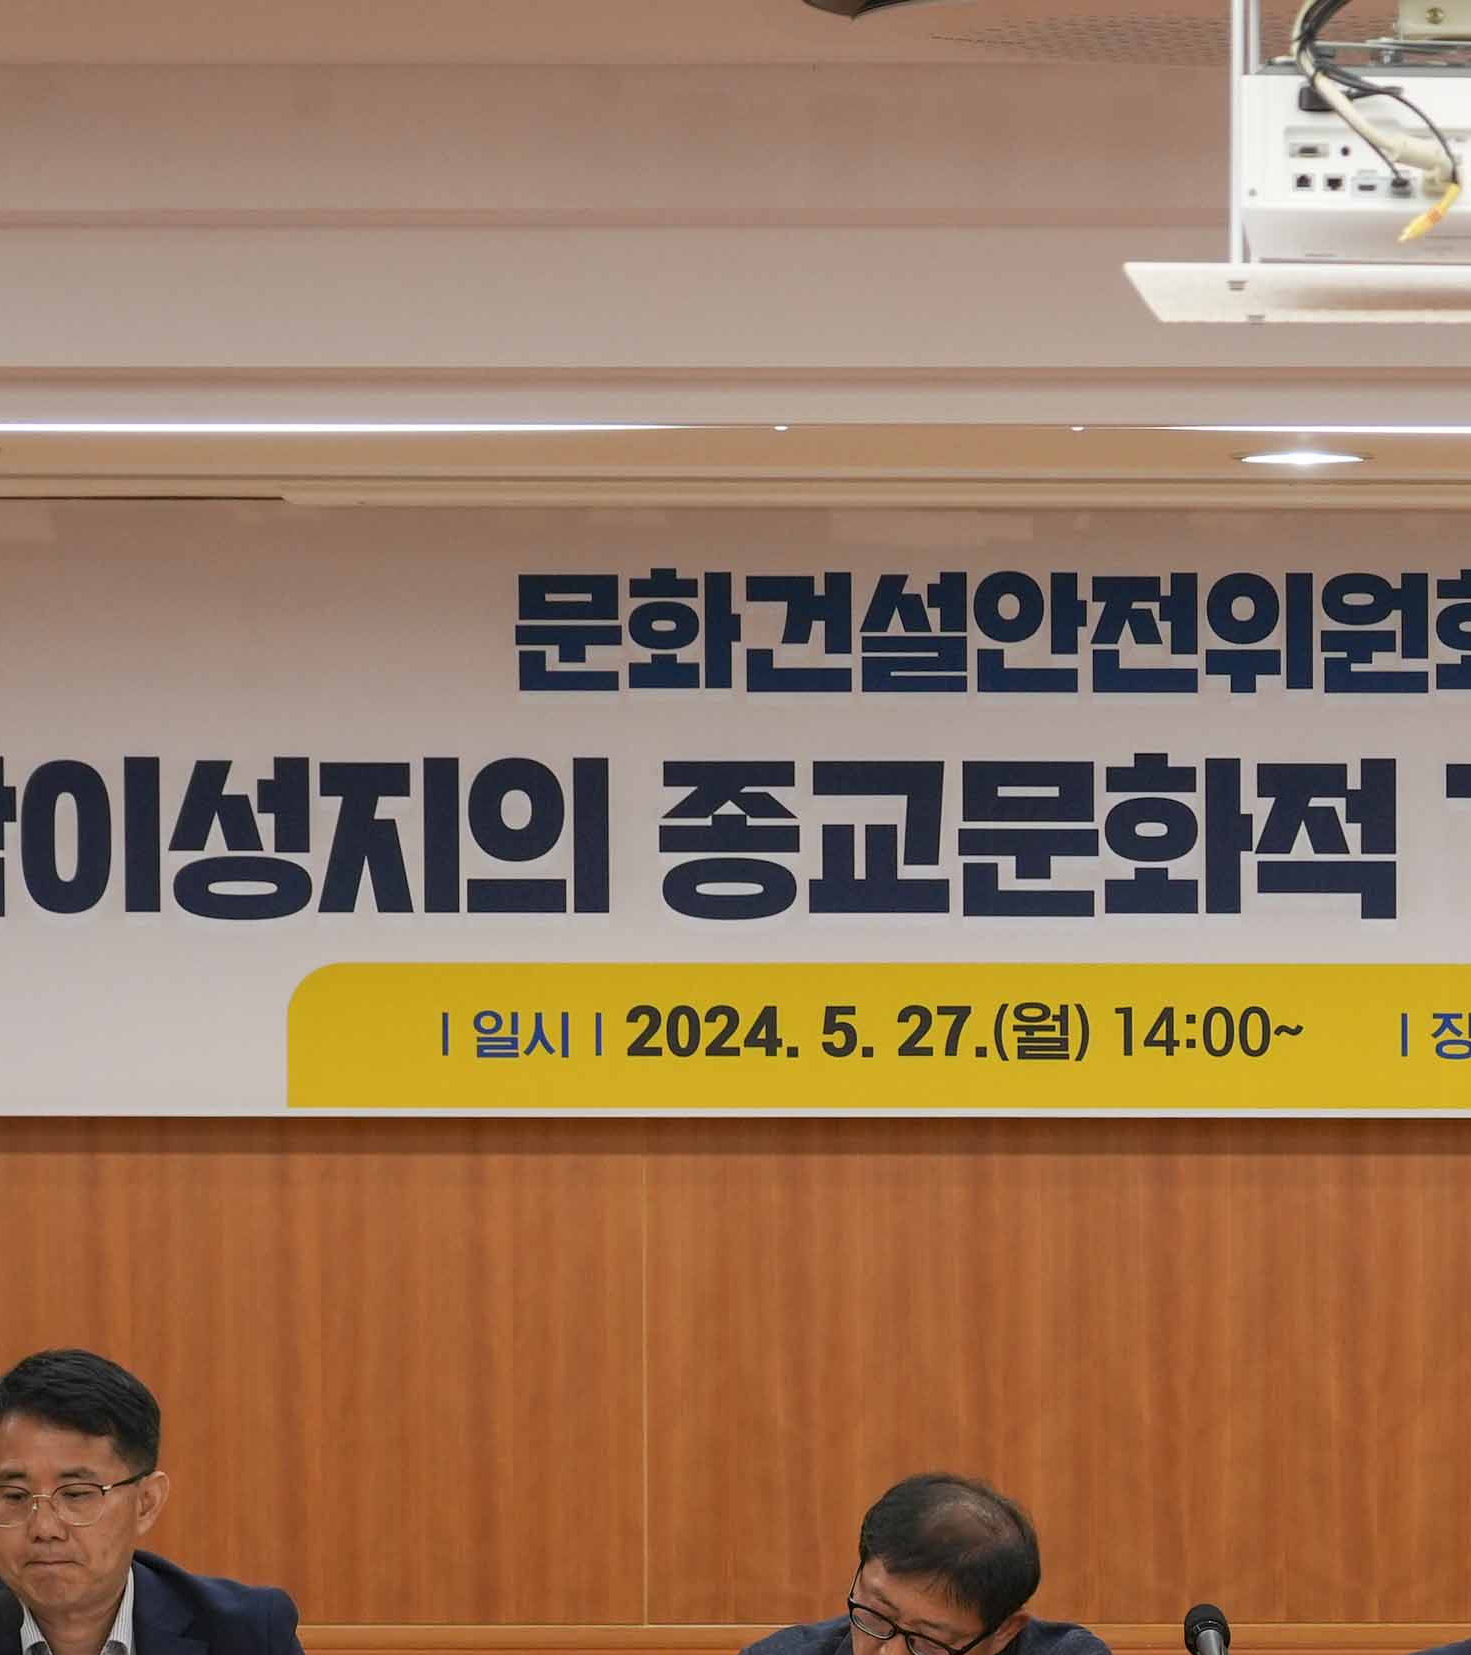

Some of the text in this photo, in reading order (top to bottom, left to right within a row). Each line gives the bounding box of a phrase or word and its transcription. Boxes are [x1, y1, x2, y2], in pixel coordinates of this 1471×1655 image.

[659, 753, 1396, 920] 종교문화적
[474, 1011, 568, 1058] 일시
[626, 1005, 798, 1057] 2024.
[822, 1006, 874, 1057] 5.
[1115, 1006, 1303, 1057] 14:00~
